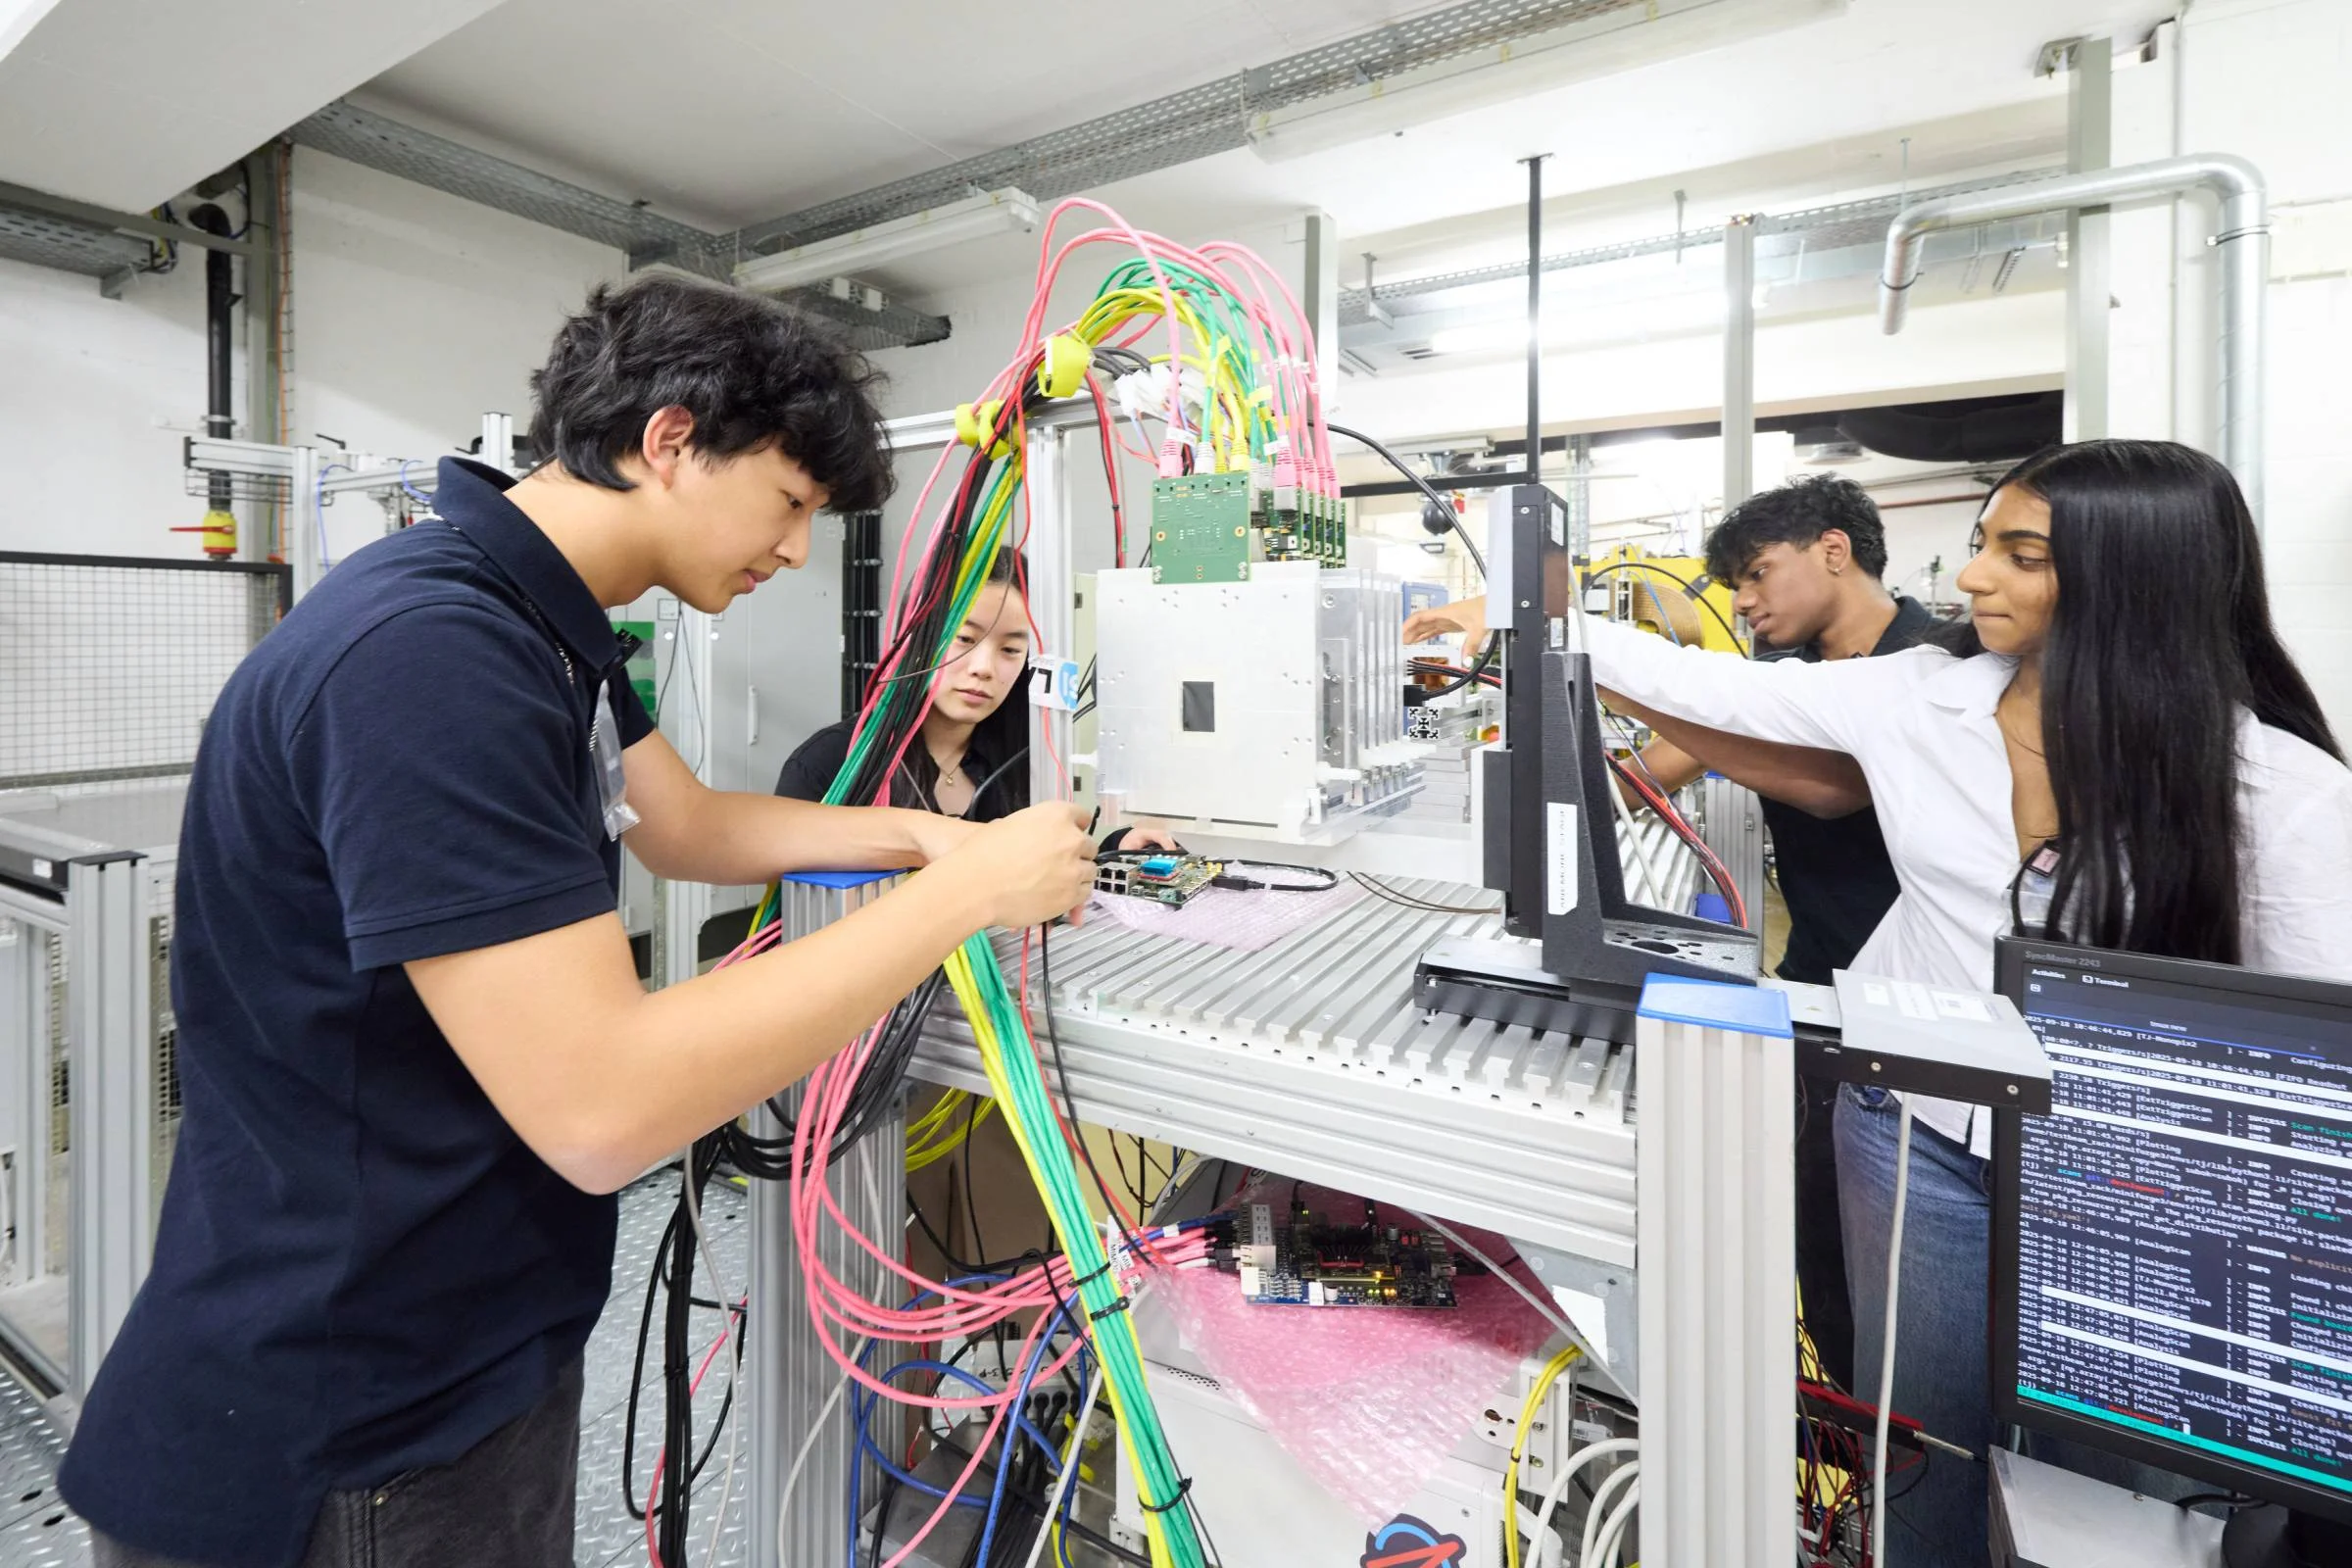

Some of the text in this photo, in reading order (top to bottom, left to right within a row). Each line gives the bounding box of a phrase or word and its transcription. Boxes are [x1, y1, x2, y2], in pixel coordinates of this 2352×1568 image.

[2248, 1051, 2270, 1059] INFO
[2248, 1114, 2285, 1127] SUCCESS
[2248, 1124, 2270, 1134] INFO
[2248, 1133, 2270, 1143] INFO
[2247, 1161, 2270, 1171] INFO
[2247, 1189, 2270, 1199] INFO
[2185, 1195, 2217, 1207] python
[2247, 1198, 2285, 1211] SUCCESS
[2120, 1207, 2150, 1221] import
[2165, 1208, 2180, 1217] The
[2258, 1228, 2297, 1244] package
[2247, 1263, 2270, 1274] INFO
[2247, 1282, 2270, 1294] INFO
[2247, 1292, 2270, 1302] INFO
[2247, 1300, 2285, 1316] SUCCESS
[2247, 1310, 2270, 1322] INFO
[2247, 1320, 2270, 1331] INFO
[2247, 1329, 2270, 1341] INFO
[2247, 1348, 2285, 1364] SUCCESS
[2247, 1357, 2270, 1369] INFO
[2247, 1367, 2270, 1379] INFO
[2247, 1386, 2270, 1397] INFO
[2247, 1424, 2270, 1436] INFO
[2247, 1434, 2285, 1450] SUCCESS
